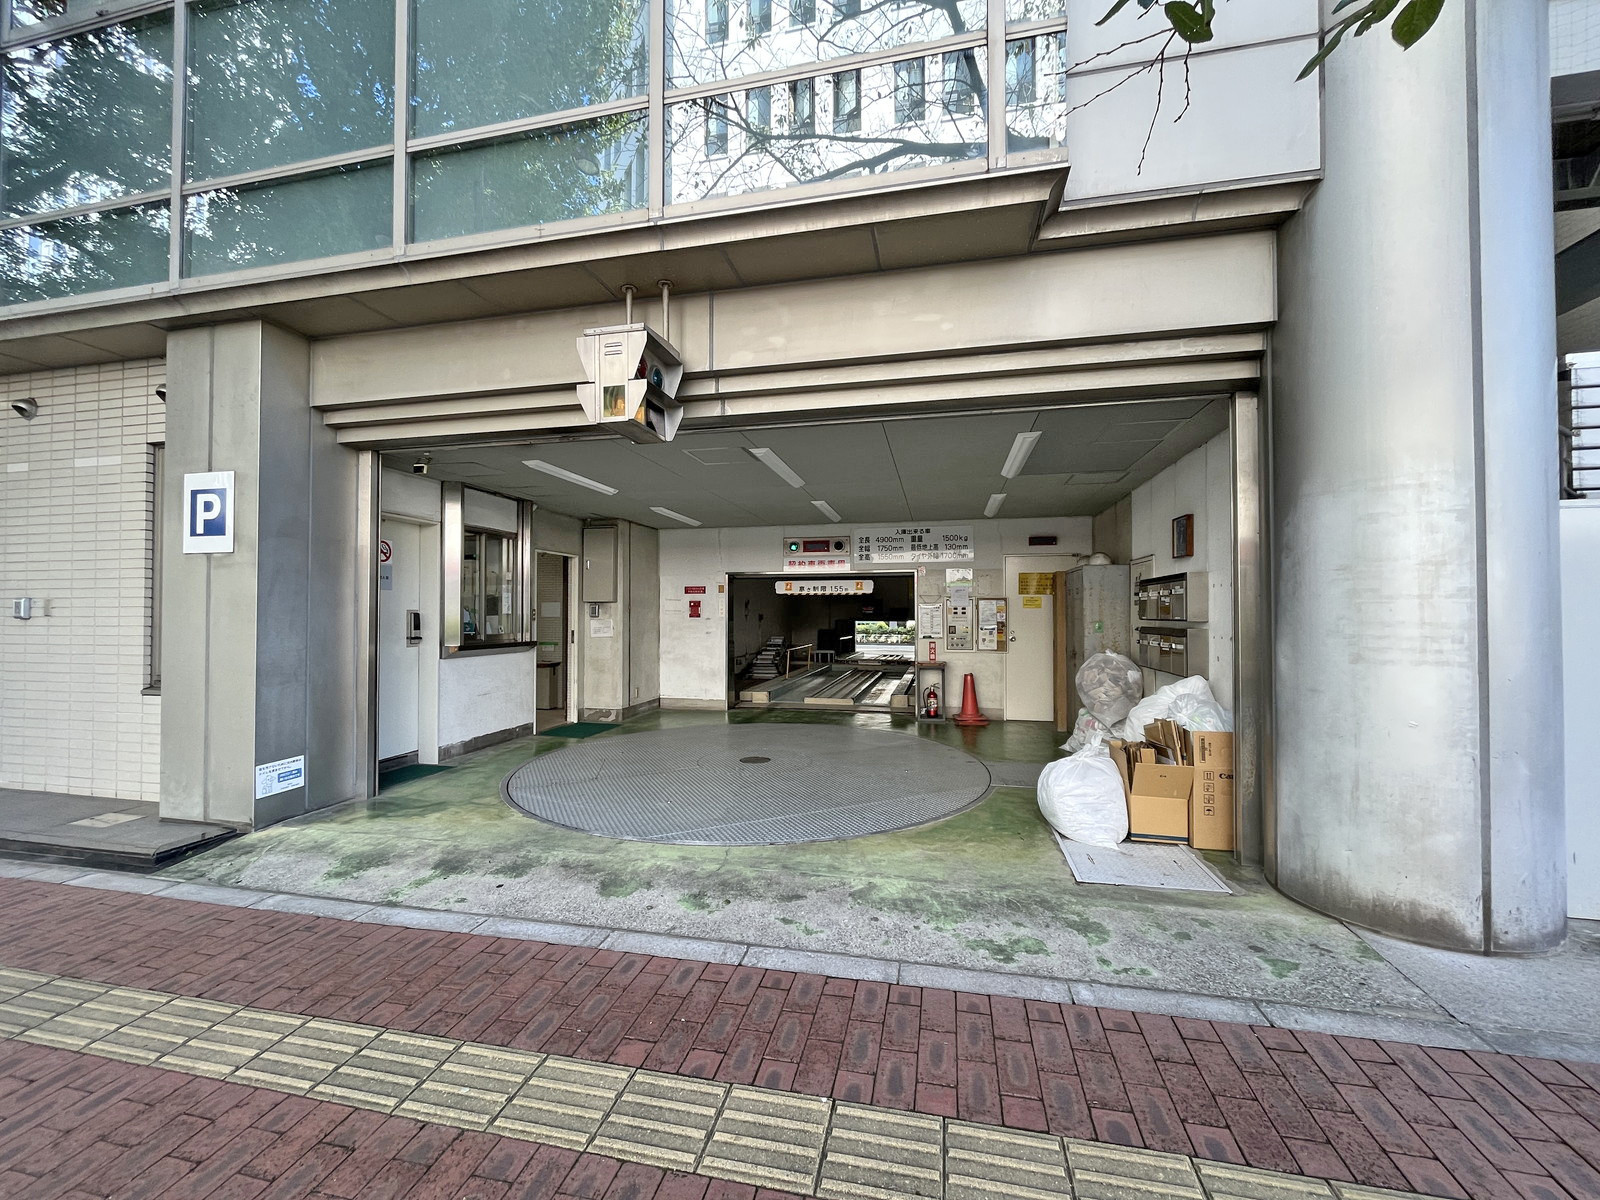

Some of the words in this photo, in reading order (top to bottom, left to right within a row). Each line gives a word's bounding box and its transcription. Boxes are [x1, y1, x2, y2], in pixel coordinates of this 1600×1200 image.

[196, 493, 221, 535] P
[858, 536, 870, 544] 全長
[942, 534, 969, 542] 1500kg
[910, 543, 939, 551] 最低地上高
[858, 553, 870, 561] 全高
